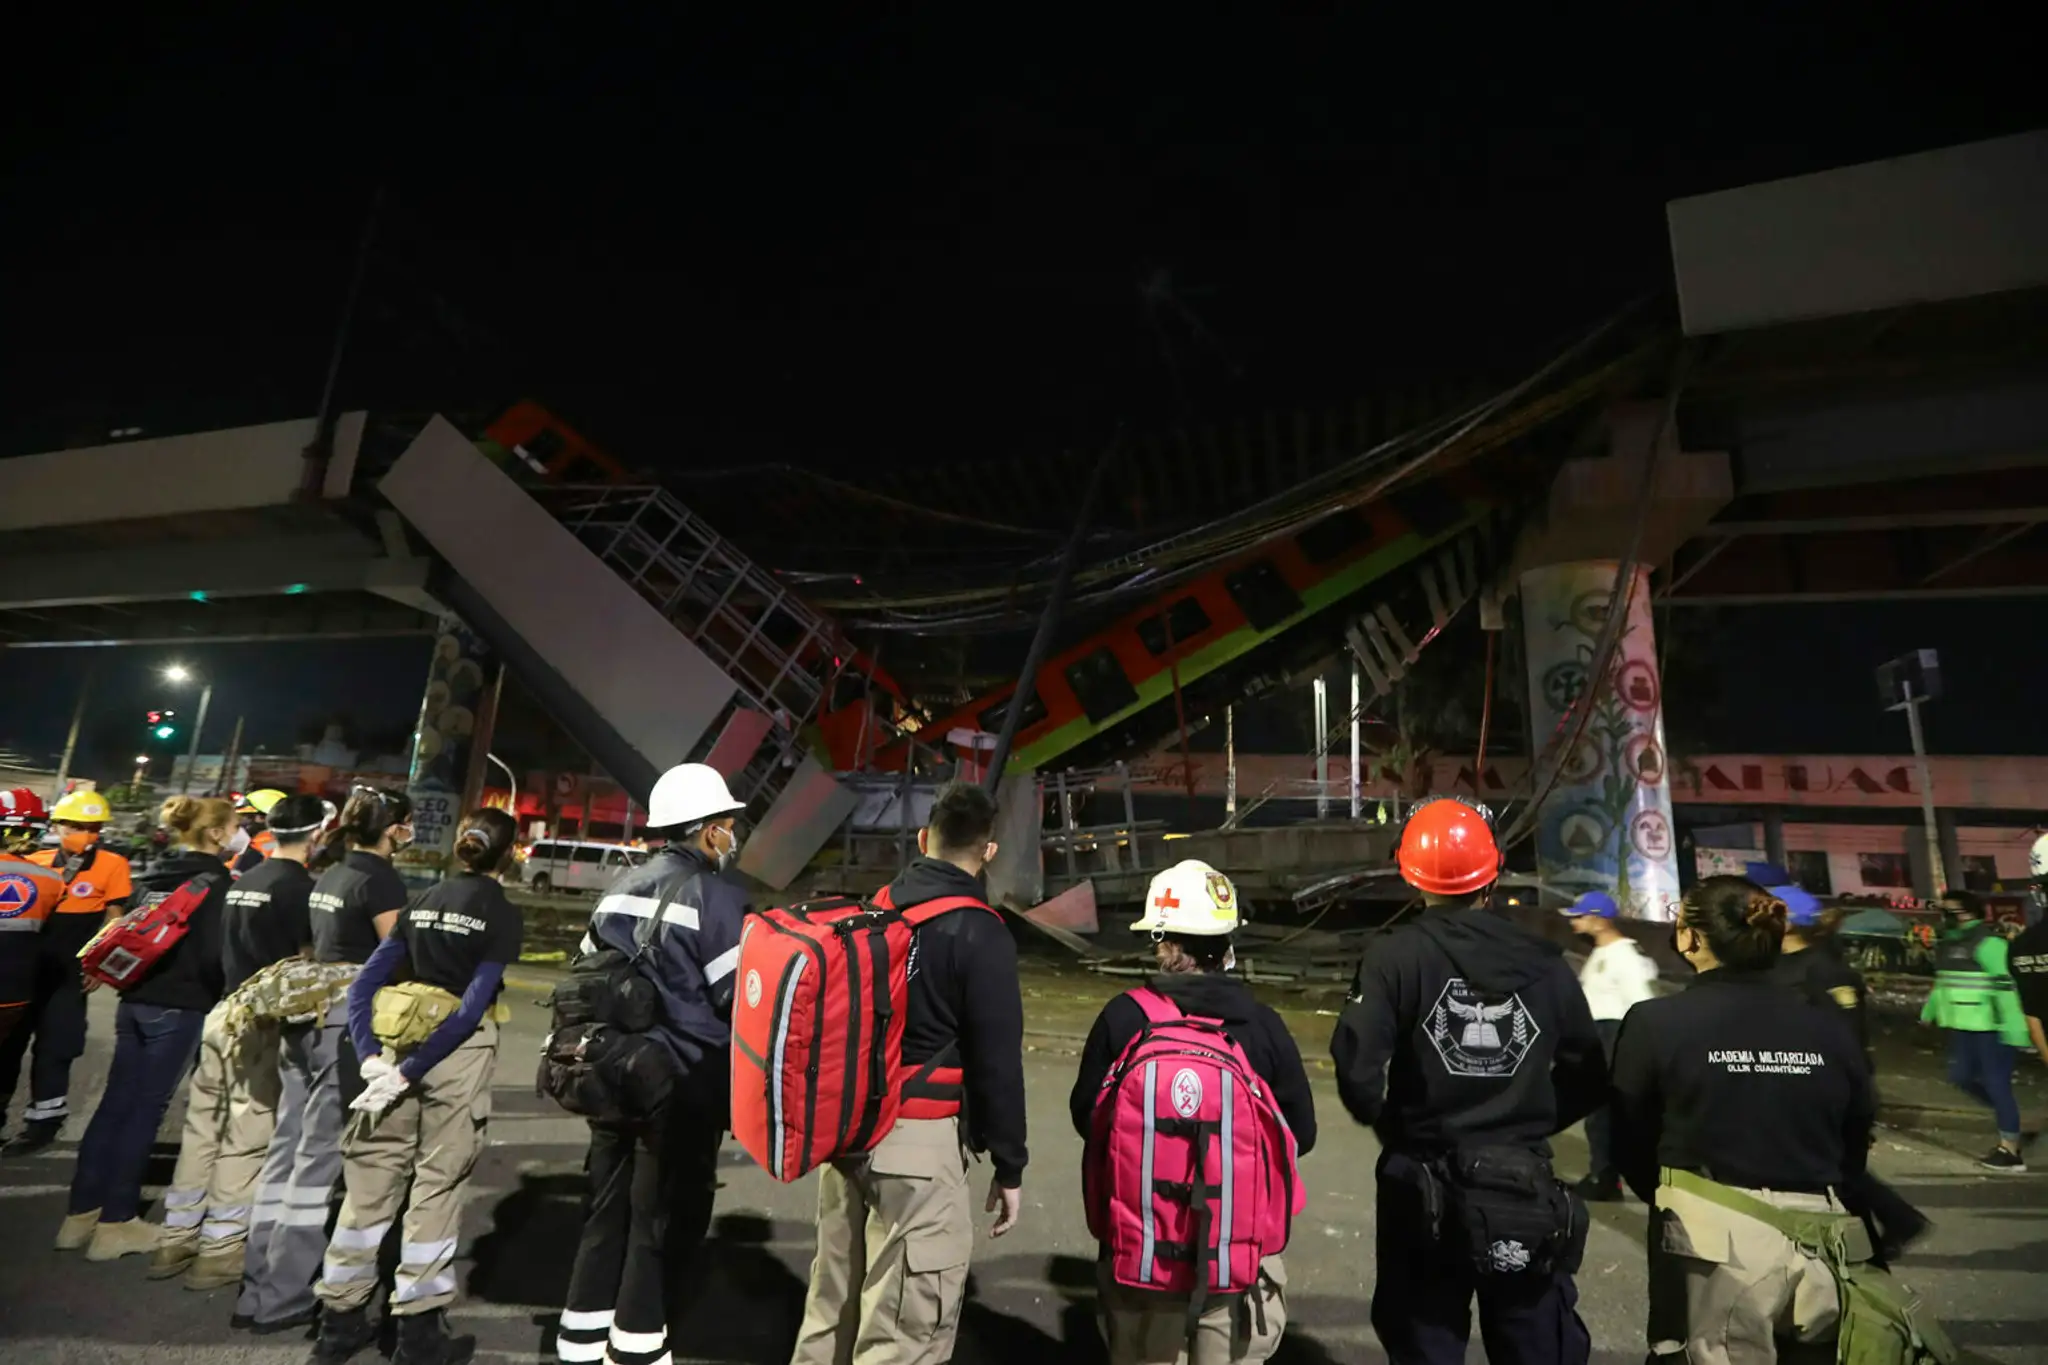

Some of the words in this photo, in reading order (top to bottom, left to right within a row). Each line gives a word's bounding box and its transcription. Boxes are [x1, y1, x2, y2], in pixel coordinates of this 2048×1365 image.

[1708, 1050, 1755, 1064] ACADEMIA
[1758, 1051, 1825, 1067] MILITARIZADA
[1727, 1064, 1751, 1073] OLLIN
